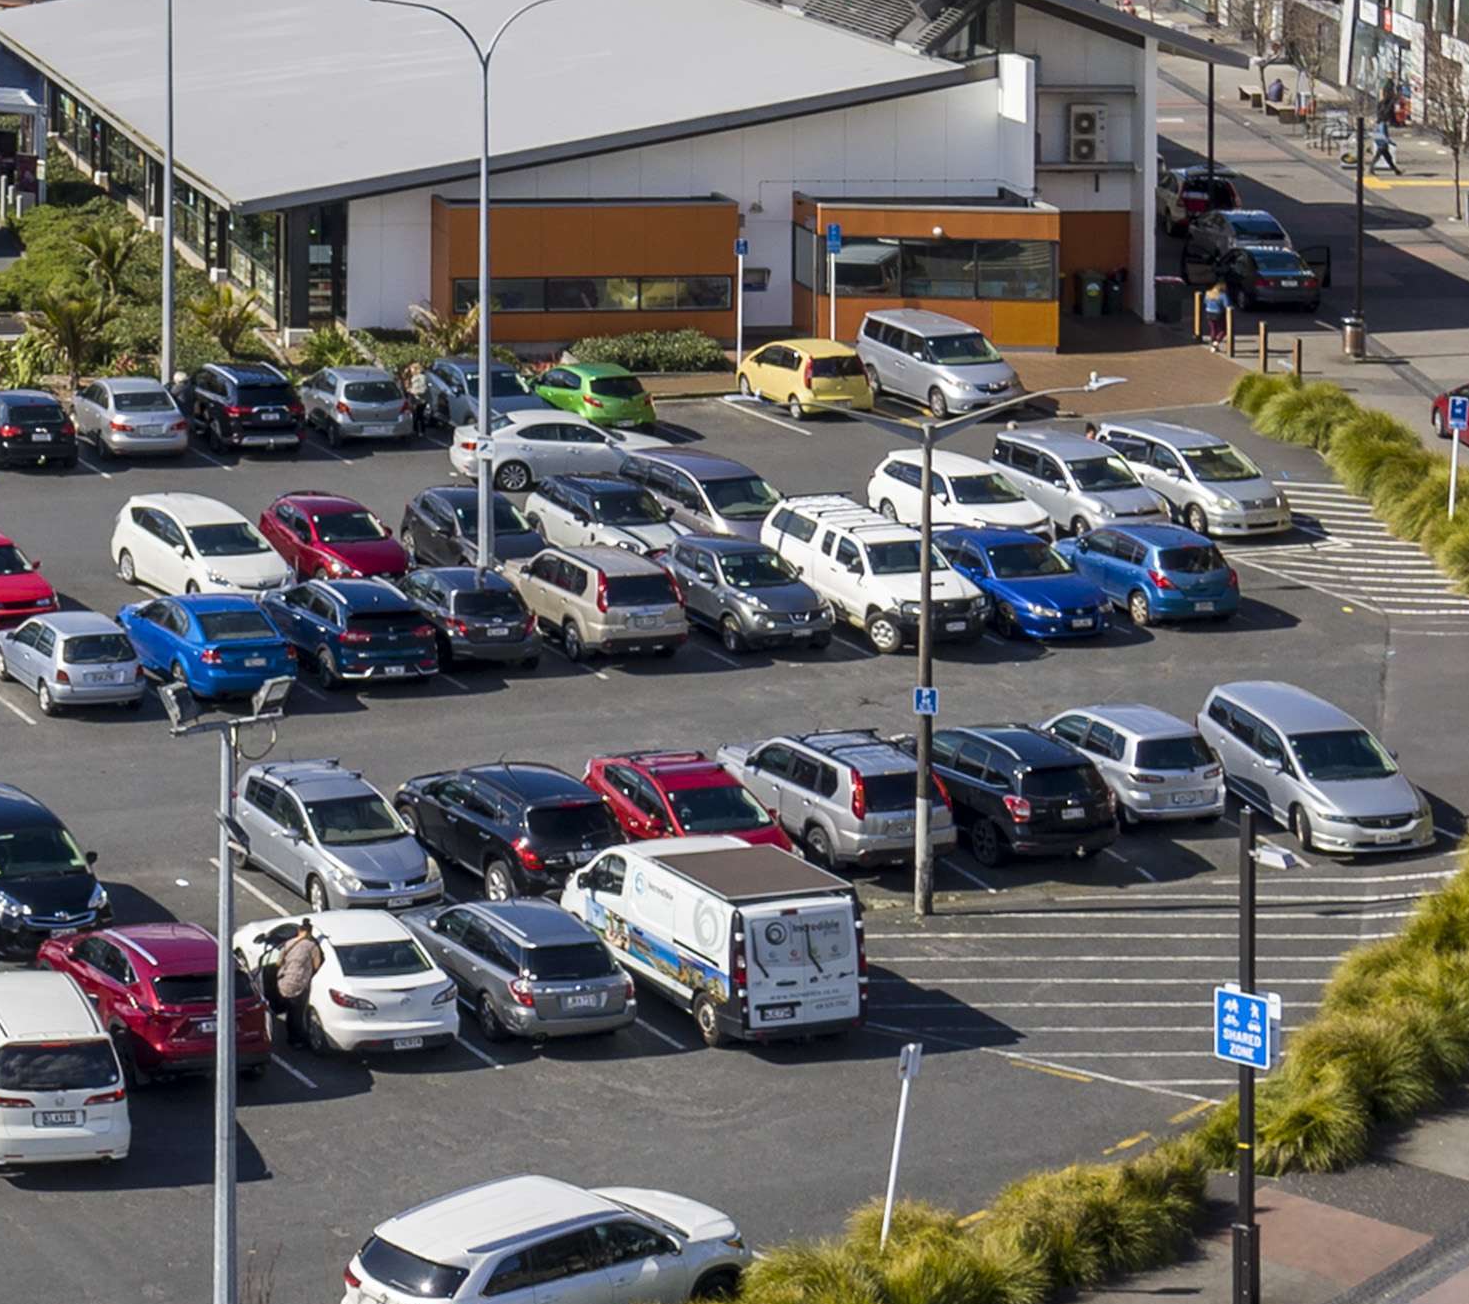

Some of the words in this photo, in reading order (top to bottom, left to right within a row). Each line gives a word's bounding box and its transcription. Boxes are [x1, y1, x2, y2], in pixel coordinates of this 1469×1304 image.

[792, 920, 839, 933] Incredible
[1222, 1027, 1262, 1048] SHARED
[1229, 1042, 1255, 1061] ZONE
